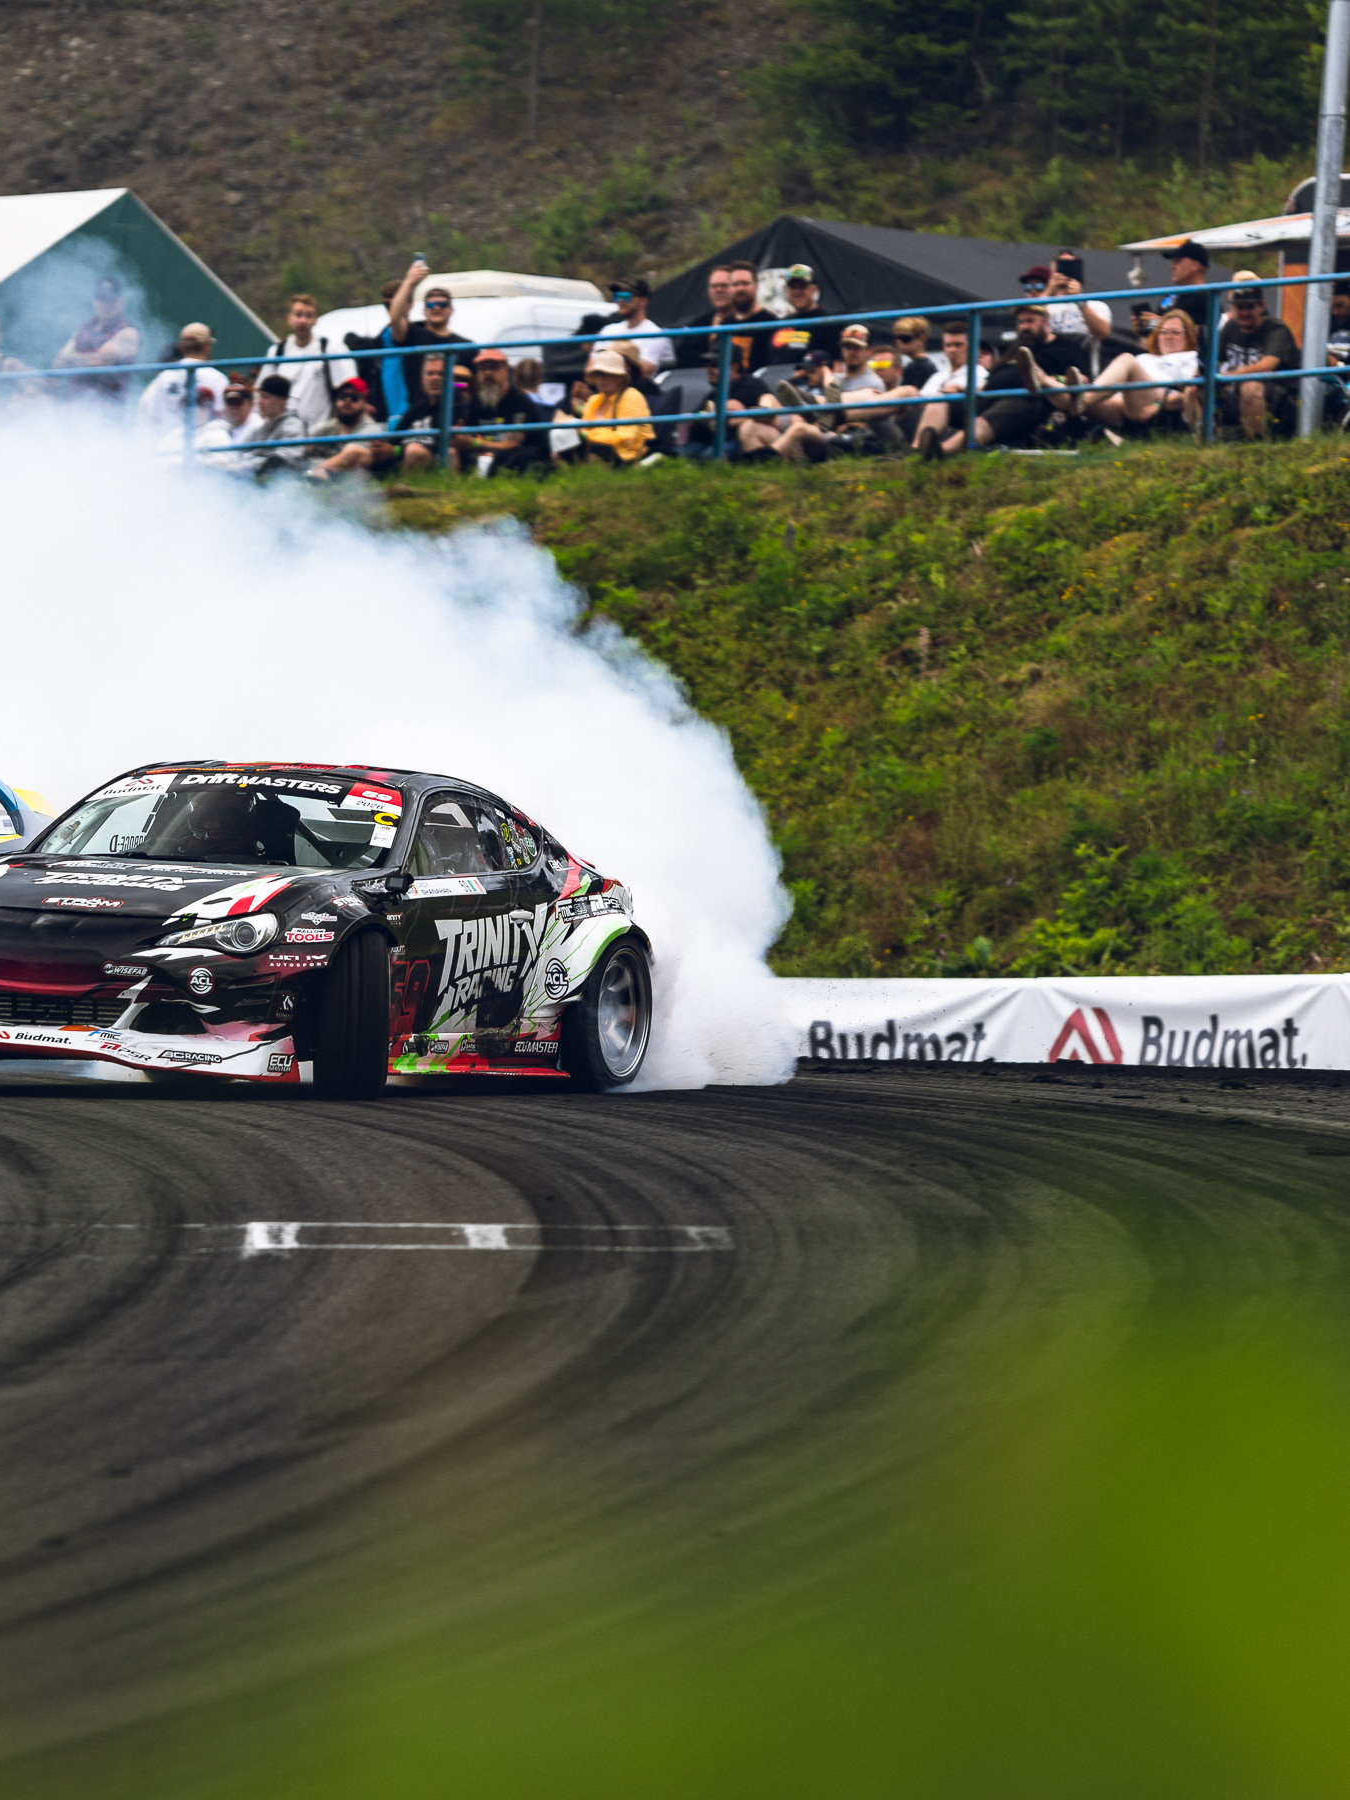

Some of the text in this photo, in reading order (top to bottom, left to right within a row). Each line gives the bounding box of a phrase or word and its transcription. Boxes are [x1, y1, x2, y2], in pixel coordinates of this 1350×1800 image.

[373, 812, 400, 826] C
[286, 932, 334, 942] TOOLS
[435, 902, 547, 996] TRINITY
[189, 977, 214, 986] ACL
[546, 972, 568, 985] ACL
[14, 1031, 72, 1045] Budmat.
